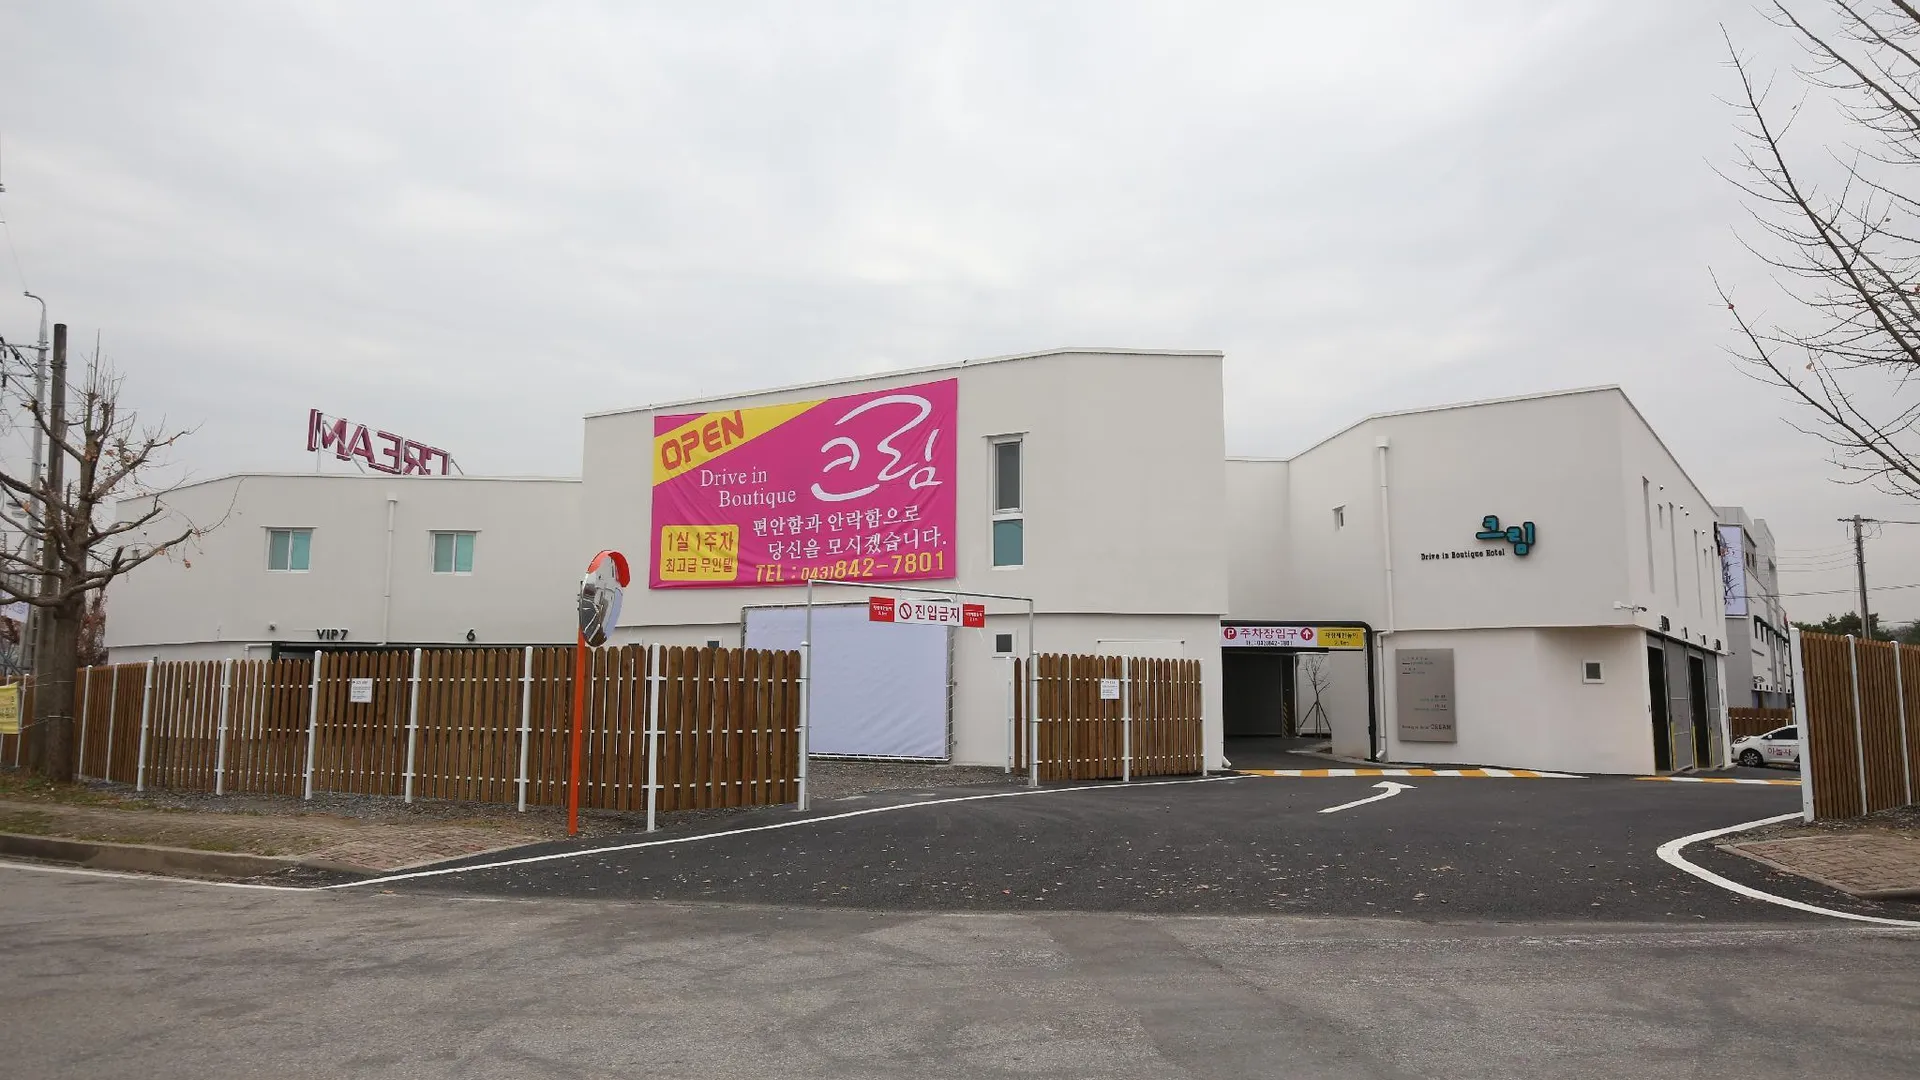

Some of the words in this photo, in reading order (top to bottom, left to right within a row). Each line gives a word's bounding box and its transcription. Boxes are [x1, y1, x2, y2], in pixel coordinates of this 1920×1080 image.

[661, 410, 745, 471] OPEN
[700, 470, 747, 487] Drive
[751, 466, 767, 484] in
[719, 488, 797, 509] Boutique
[753, 513, 822, 537] 편안함과
[827, 505, 921, 533] 안락함으로
[667, 532, 690, 552] 1실
[695, 530, 734, 552] 1주차
[768, 537, 821, 561] 당신을
[826, 526, 947, 556] 모시겠습니다.
[1421, 552, 1440, 561] Drive
[1451, 550, 1484, 559] Boutique
[1486, 548, 1505, 557] Hotel
[665, 558, 697, 573] 최고급
[700, 557, 733, 573] 무인텔
[755, 564, 784, 583] TEL
[915, 604, 960, 622] 진입금지
[466, 628, 476, 642] 6
[1240, 628, 1298, 639] 주차장입구
